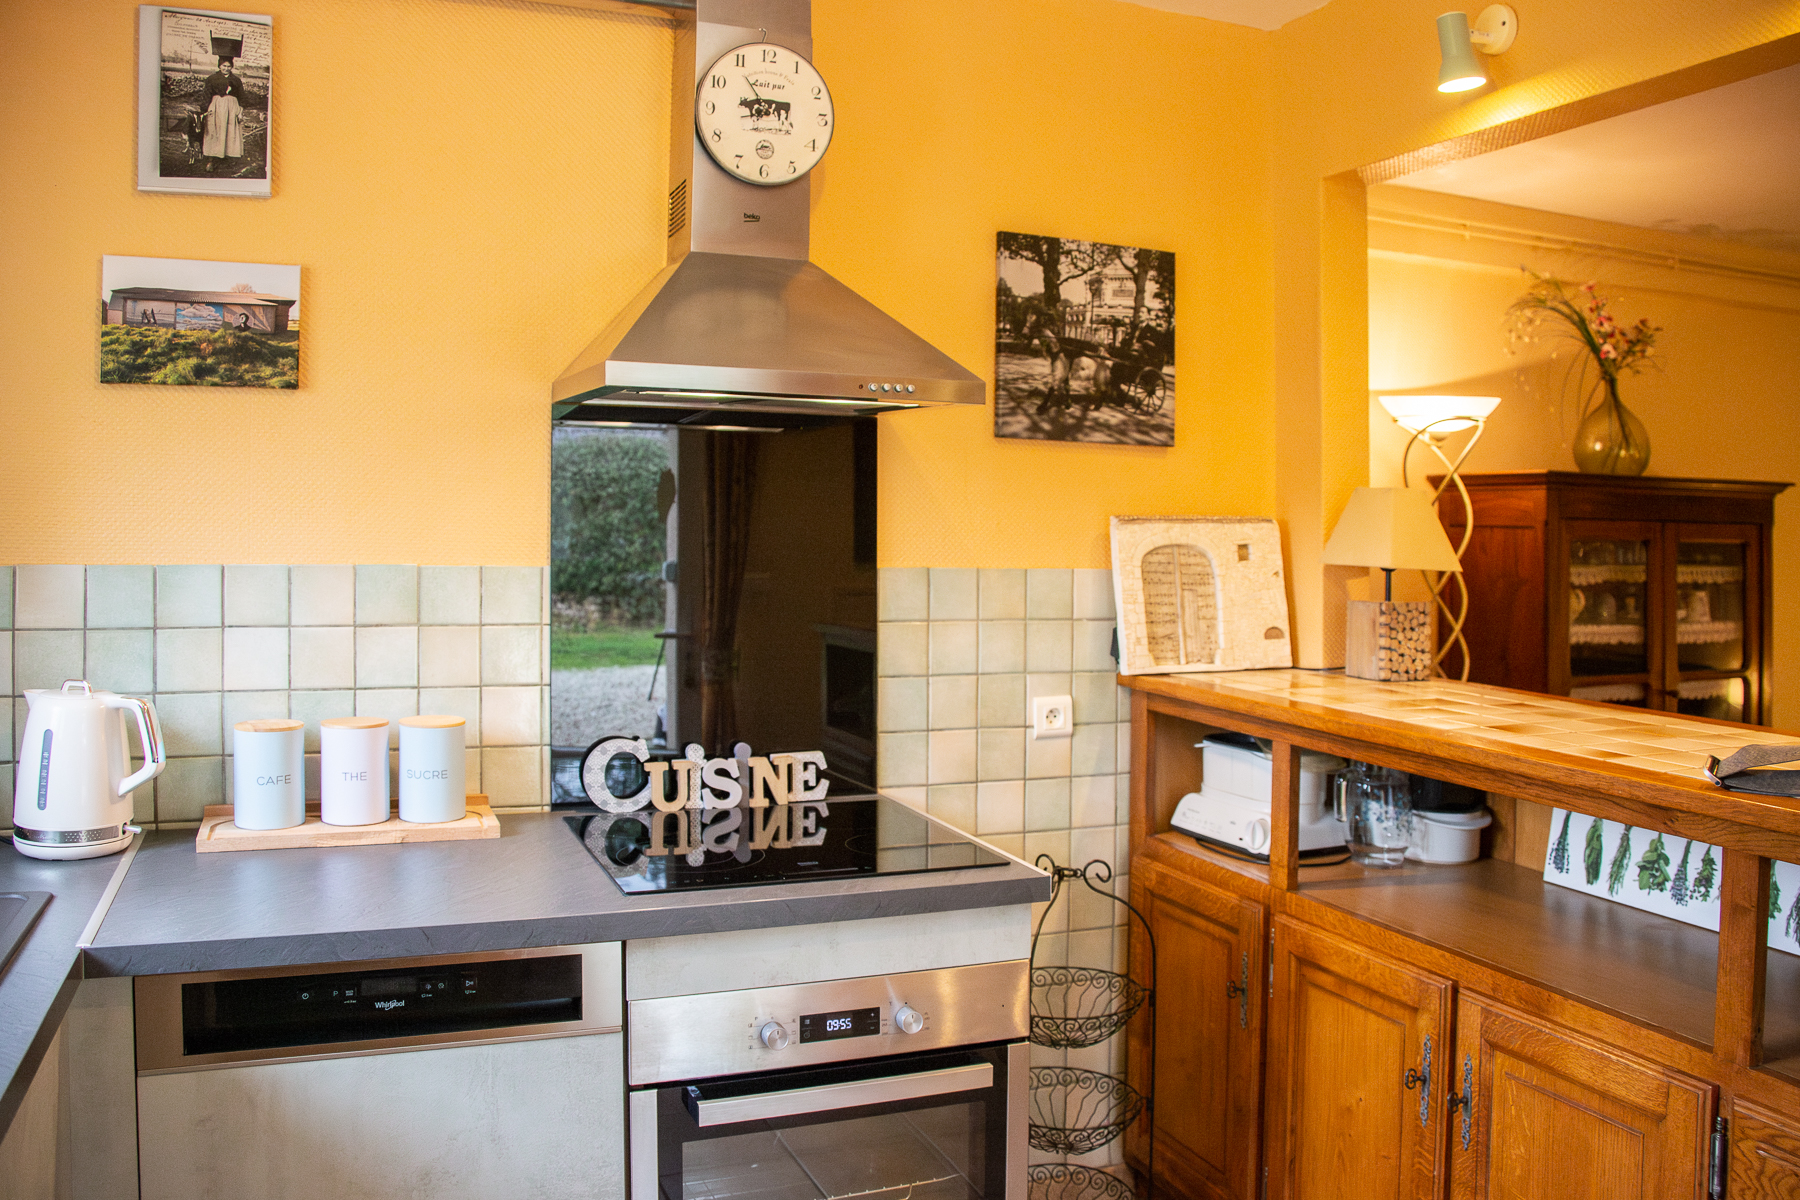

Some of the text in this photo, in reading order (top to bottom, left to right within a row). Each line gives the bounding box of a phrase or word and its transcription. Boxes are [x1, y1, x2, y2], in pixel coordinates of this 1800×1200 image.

[734, 53, 746, 68] 11
[761, 49, 777, 63] 12
[794, 61, 800, 74] 1
[710, 74, 727, 89] 10
[771, 83, 786, 91] pur
[811, 86, 821, 100] 2
[705, 100, 716, 115] 9
[817, 113, 828, 127] 3
[711, 128, 722, 143] 8
[803, 138, 819, 152] 4
[733, 154, 744, 169] 7
[787, 160, 797, 174] 5
[759, 164, 769, 179] 6
[743, 212, 761, 220] beko
[256, 774, 292, 786] CAFE
[341, 771, 368, 781] THE
[406, 769, 449, 780] SUCRE
[374, 999, 405, 1011] Whirlpool
